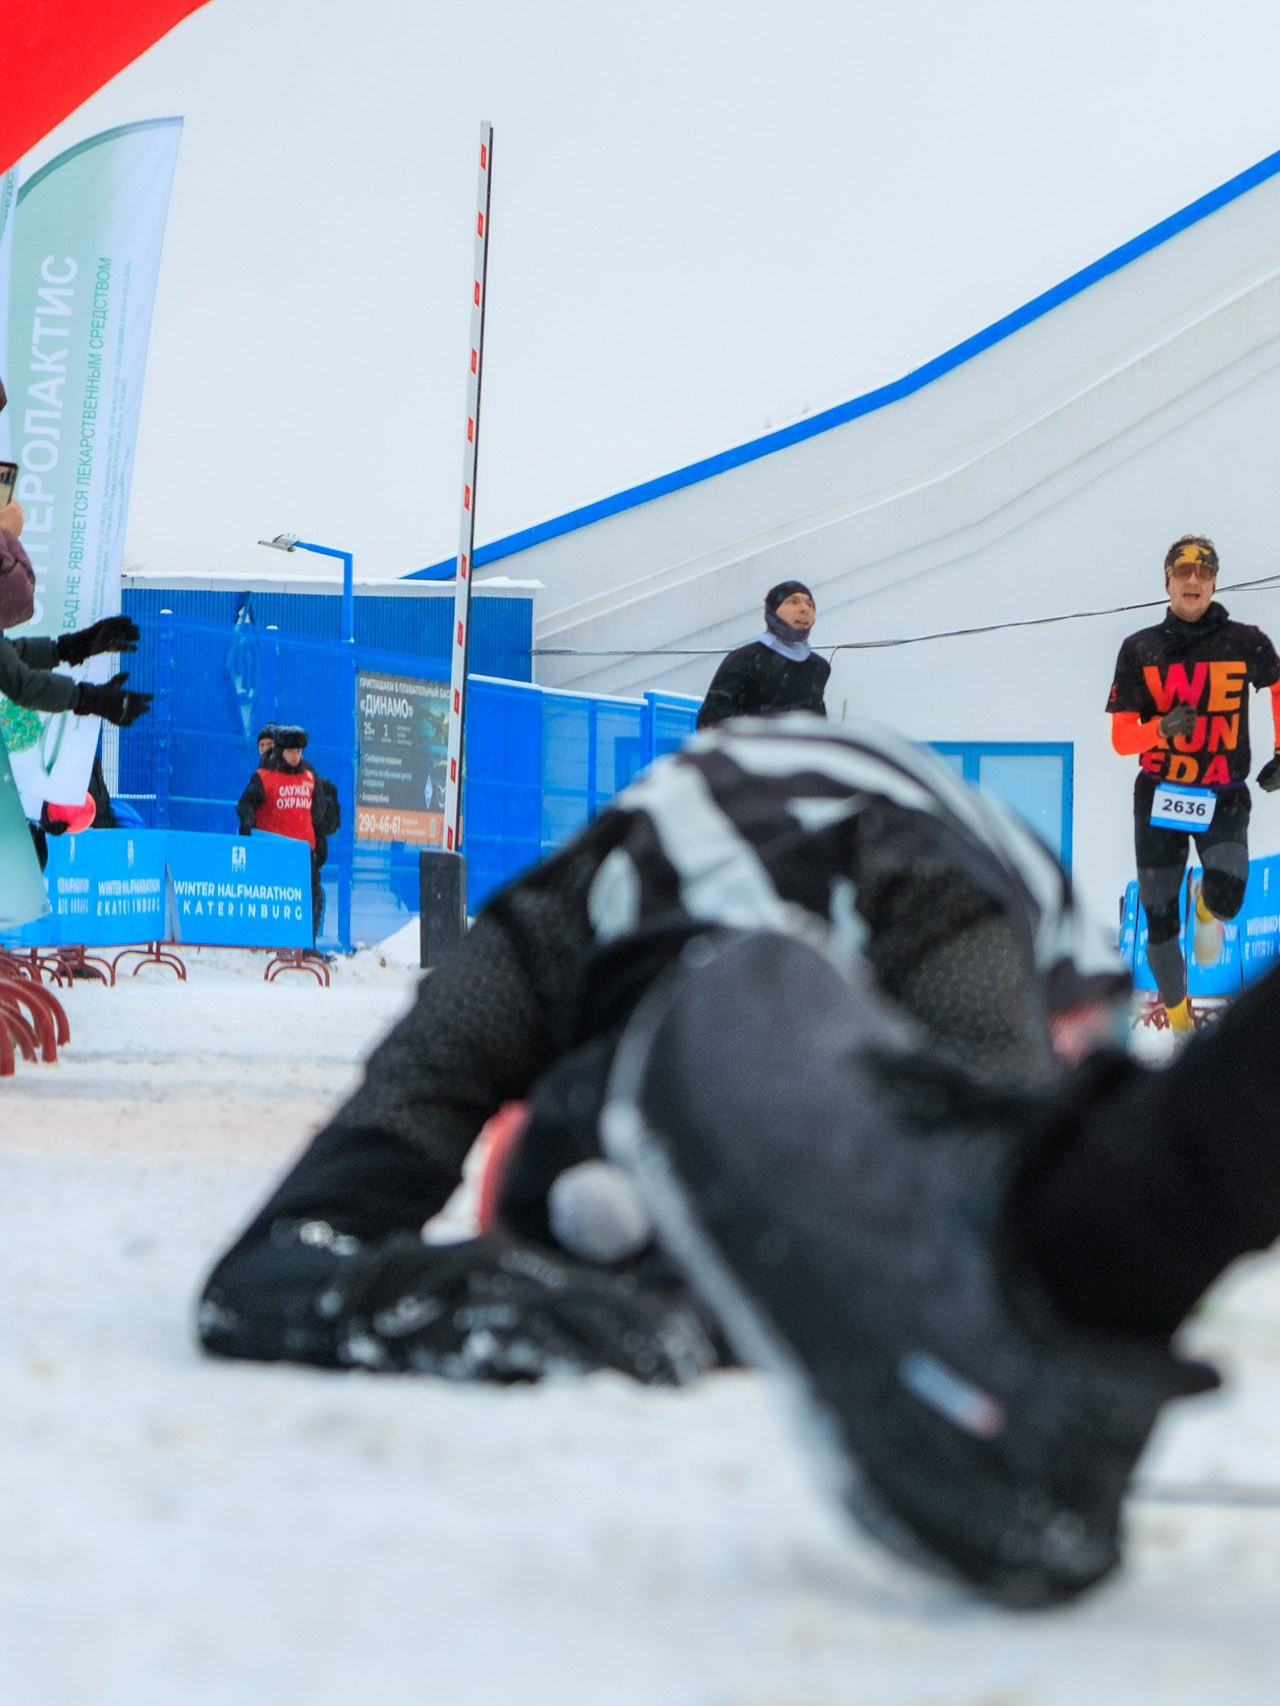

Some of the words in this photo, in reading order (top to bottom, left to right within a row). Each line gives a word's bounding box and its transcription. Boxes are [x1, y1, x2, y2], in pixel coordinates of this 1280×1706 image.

[89, 257, 112, 350] СРЕДСТВОМ
[77, 353, 103, 488] ЛЕКАРСТВЕННЫМ
[68, 487, 90, 571] ЯВЛЯЕТСЯ
[1142, 660, 1247, 713] WE
[360, 694, 414, 720] «ДИНАМО»
[384, 724, 389, 737] 2
[1153, 712, 1241, 754] UN
[1141, 752, 1232, 786] EDA
[279, 785, 310, 798] СЛУЖБА
[1162, 798, 1207, 817] 2636
[174, 880, 216, 897] WINTER
[217, 883, 302, 902] HALFMARATHON
[183, 899, 303, 921] KATERINBURG
